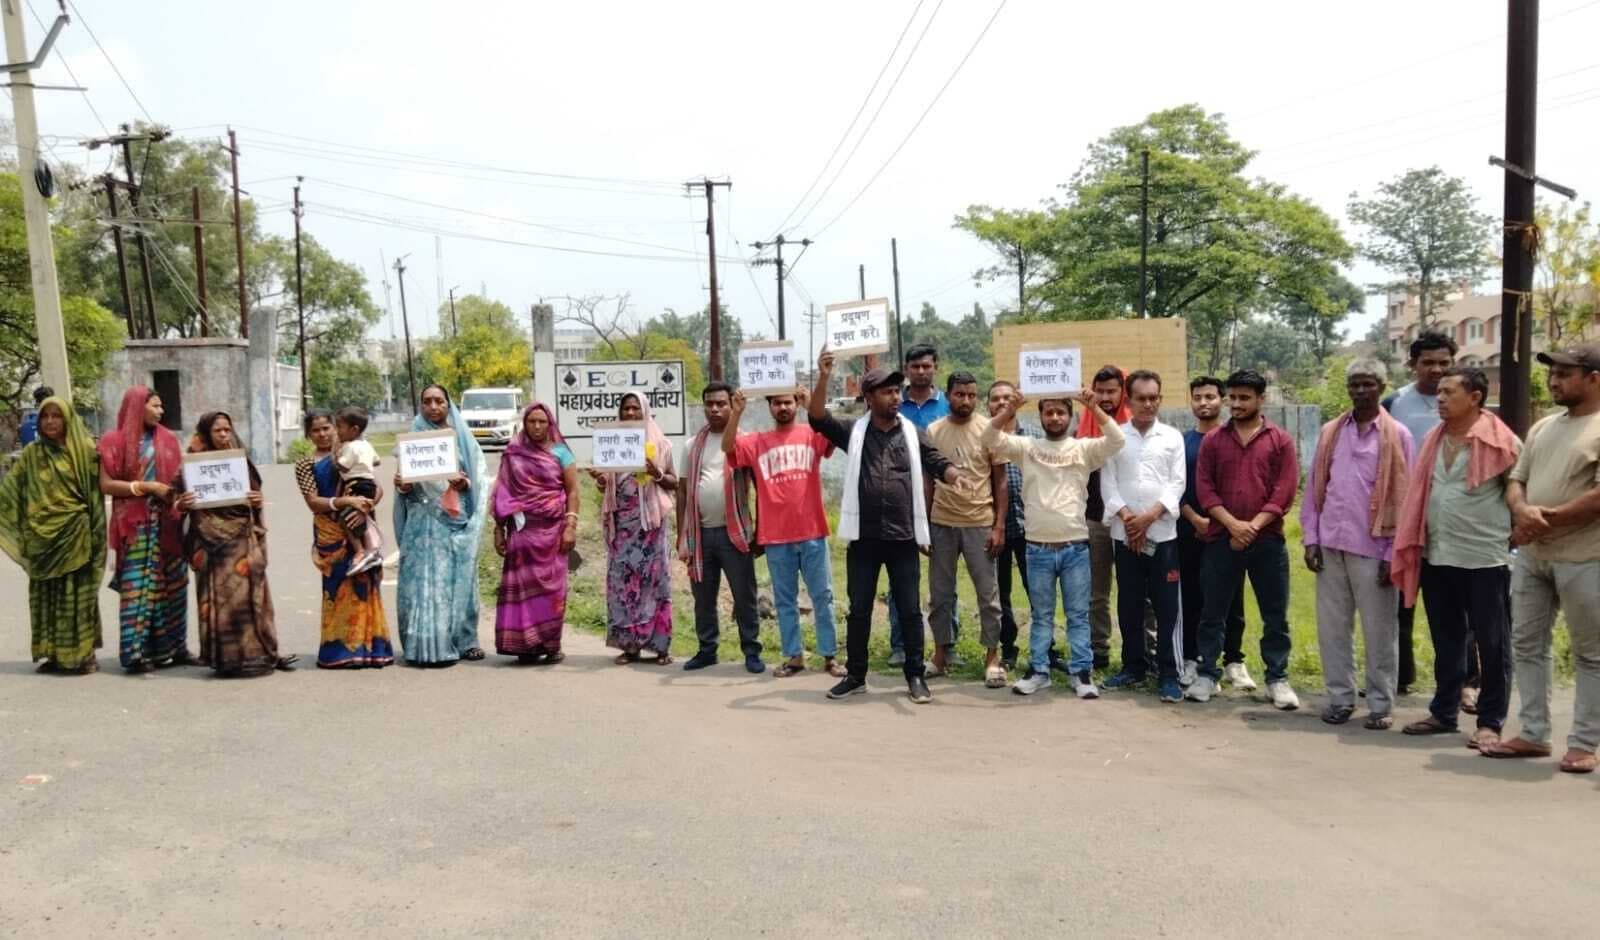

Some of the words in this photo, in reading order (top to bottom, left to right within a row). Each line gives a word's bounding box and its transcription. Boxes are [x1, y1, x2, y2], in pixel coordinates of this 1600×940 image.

[840, 310, 870, 325] प्रदूषण
[833, 330, 855, 346] मुक्त
[743, 353, 767, 366] हमारी
[1062, 354, 1073, 367] को
[1029, 371, 1056, 384] रोजगार
[199, 463, 230, 478] प्रदूषण
